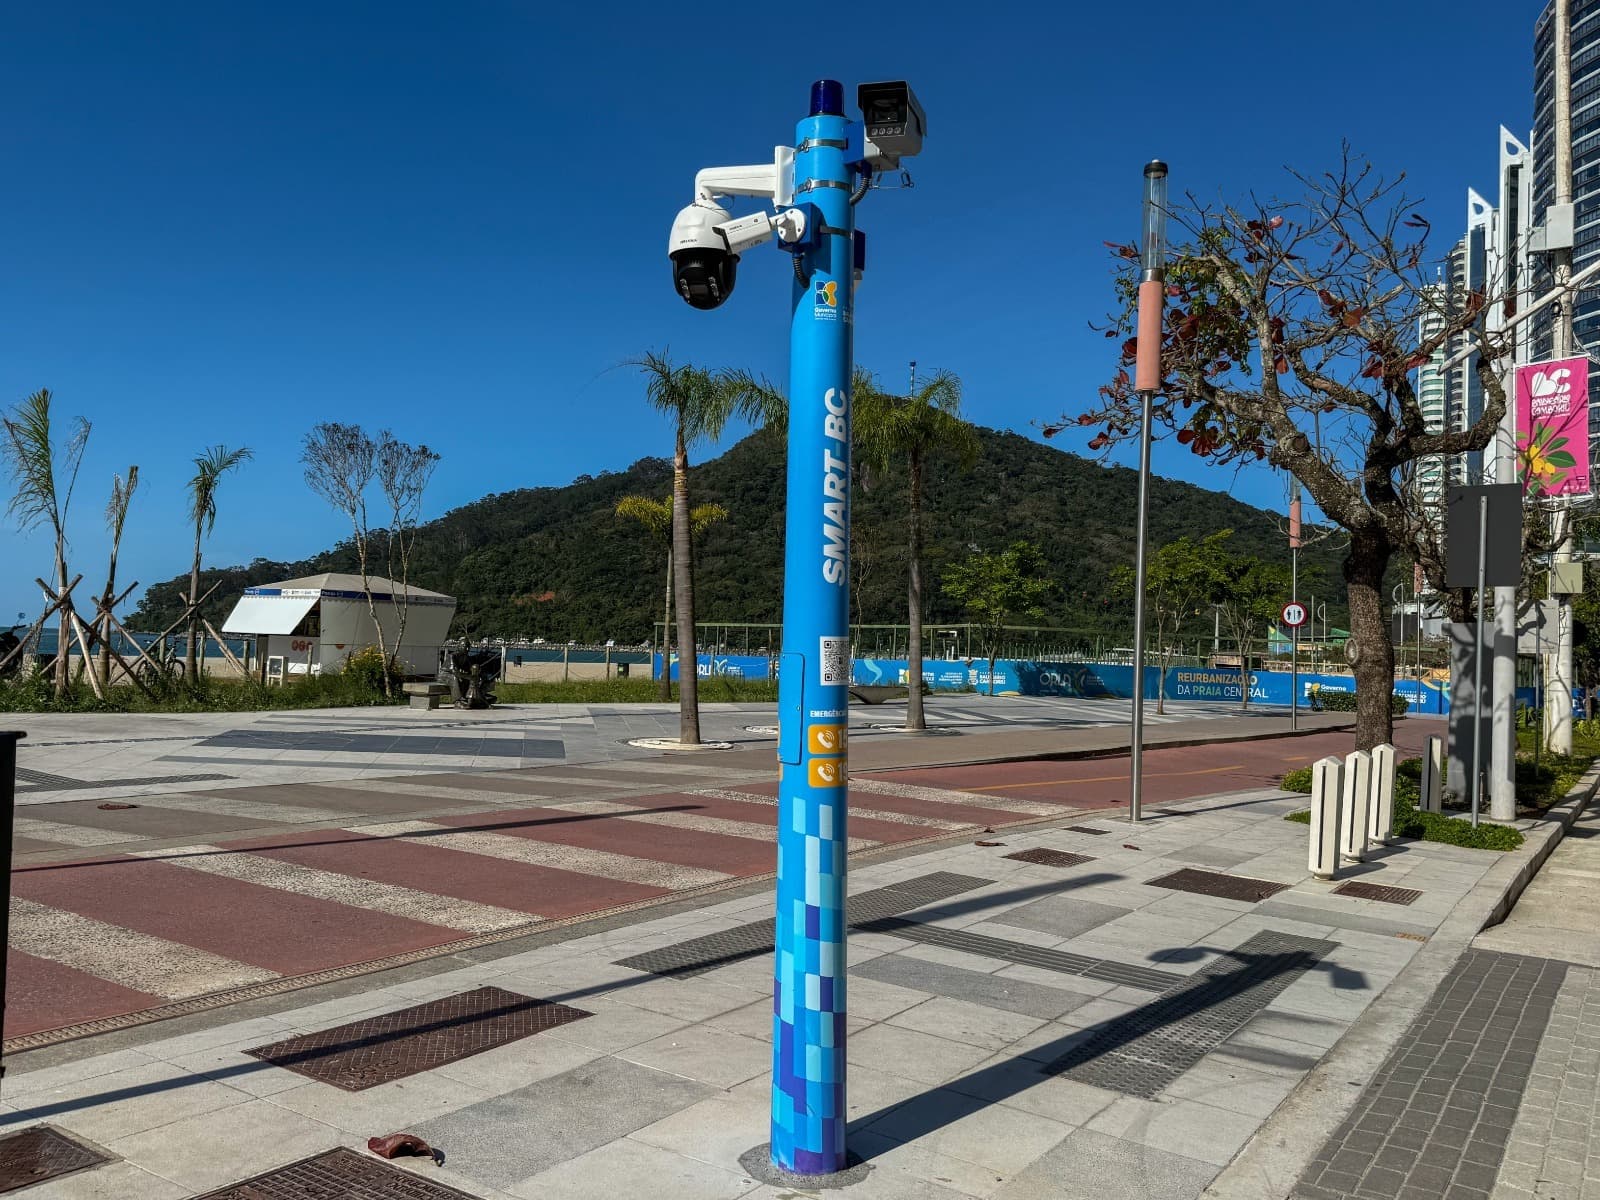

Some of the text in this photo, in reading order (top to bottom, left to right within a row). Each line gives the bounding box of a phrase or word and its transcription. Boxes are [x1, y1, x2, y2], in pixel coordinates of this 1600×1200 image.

[822, 387, 848, 587] SMART-BC
[1040, 672, 1072, 687] ORLA
[1177, 684, 1270, 698] DA PRAIA CENRAL
